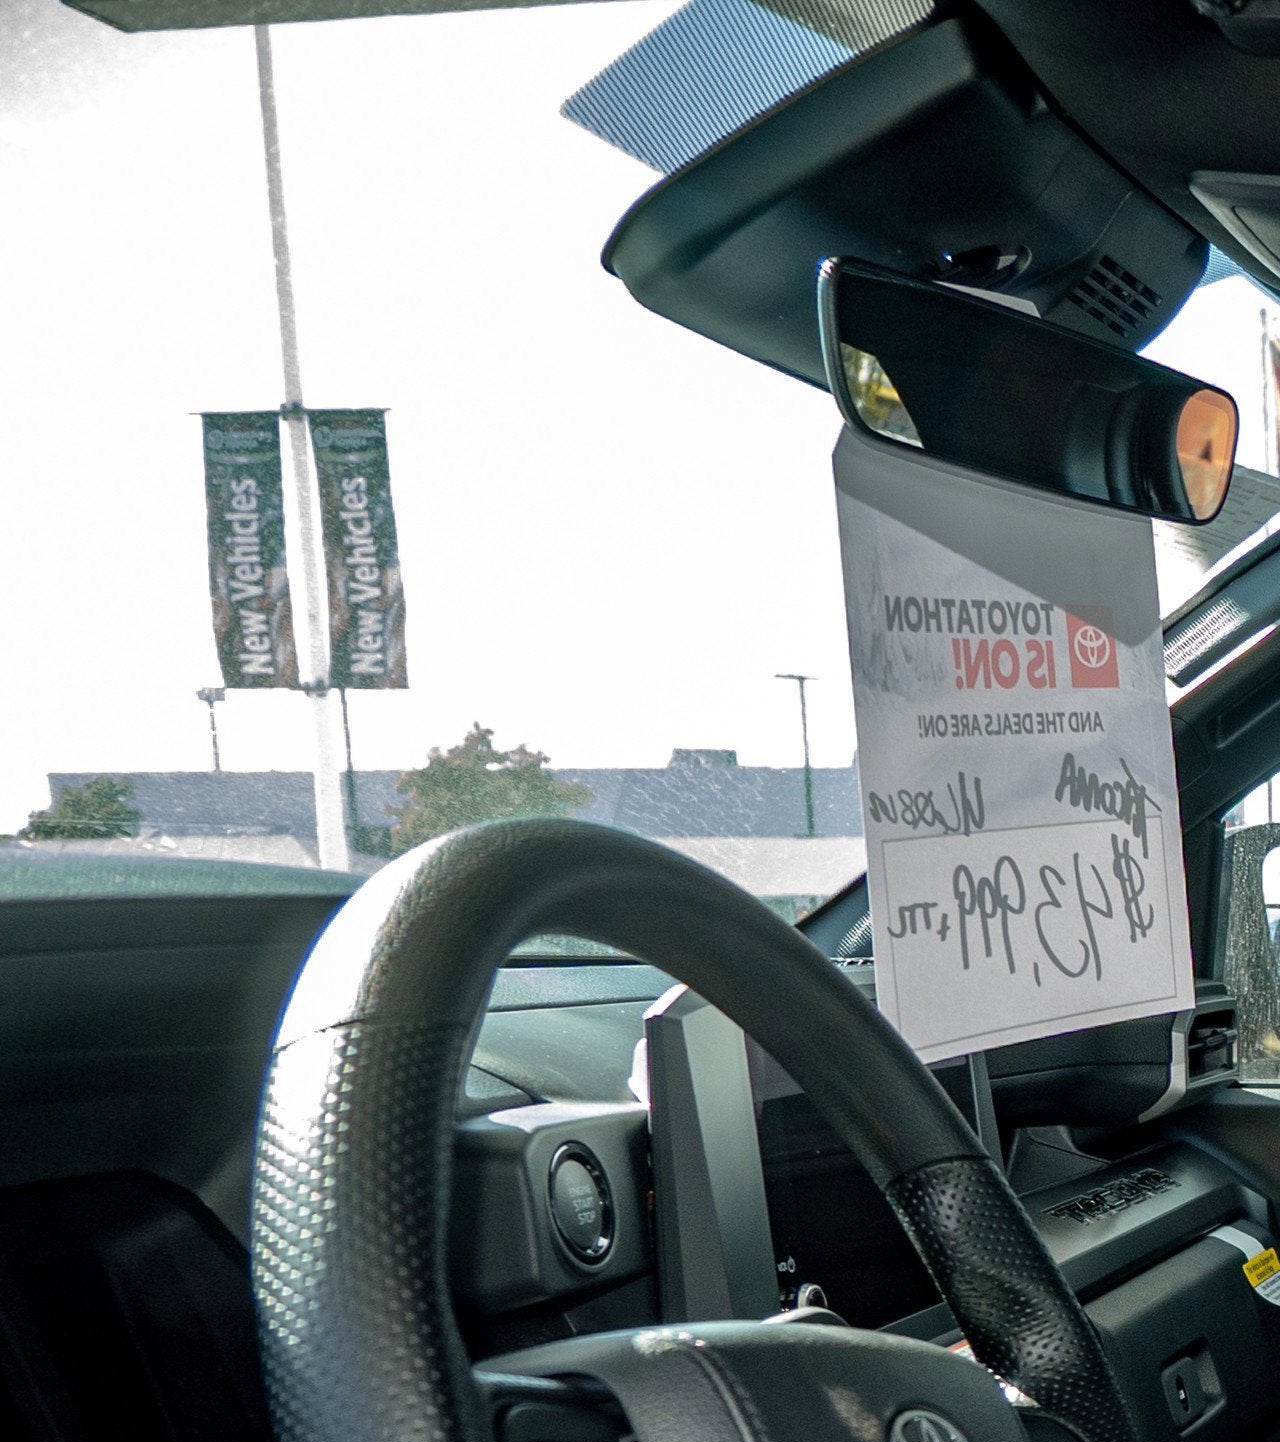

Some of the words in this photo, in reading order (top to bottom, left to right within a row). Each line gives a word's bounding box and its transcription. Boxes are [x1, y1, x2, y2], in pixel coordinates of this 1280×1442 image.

[224, 477, 266, 601] Vehicles
[339, 475, 383, 603] Vehicles
[237, 609, 275, 676] New
[349, 609, 387, 675] New
